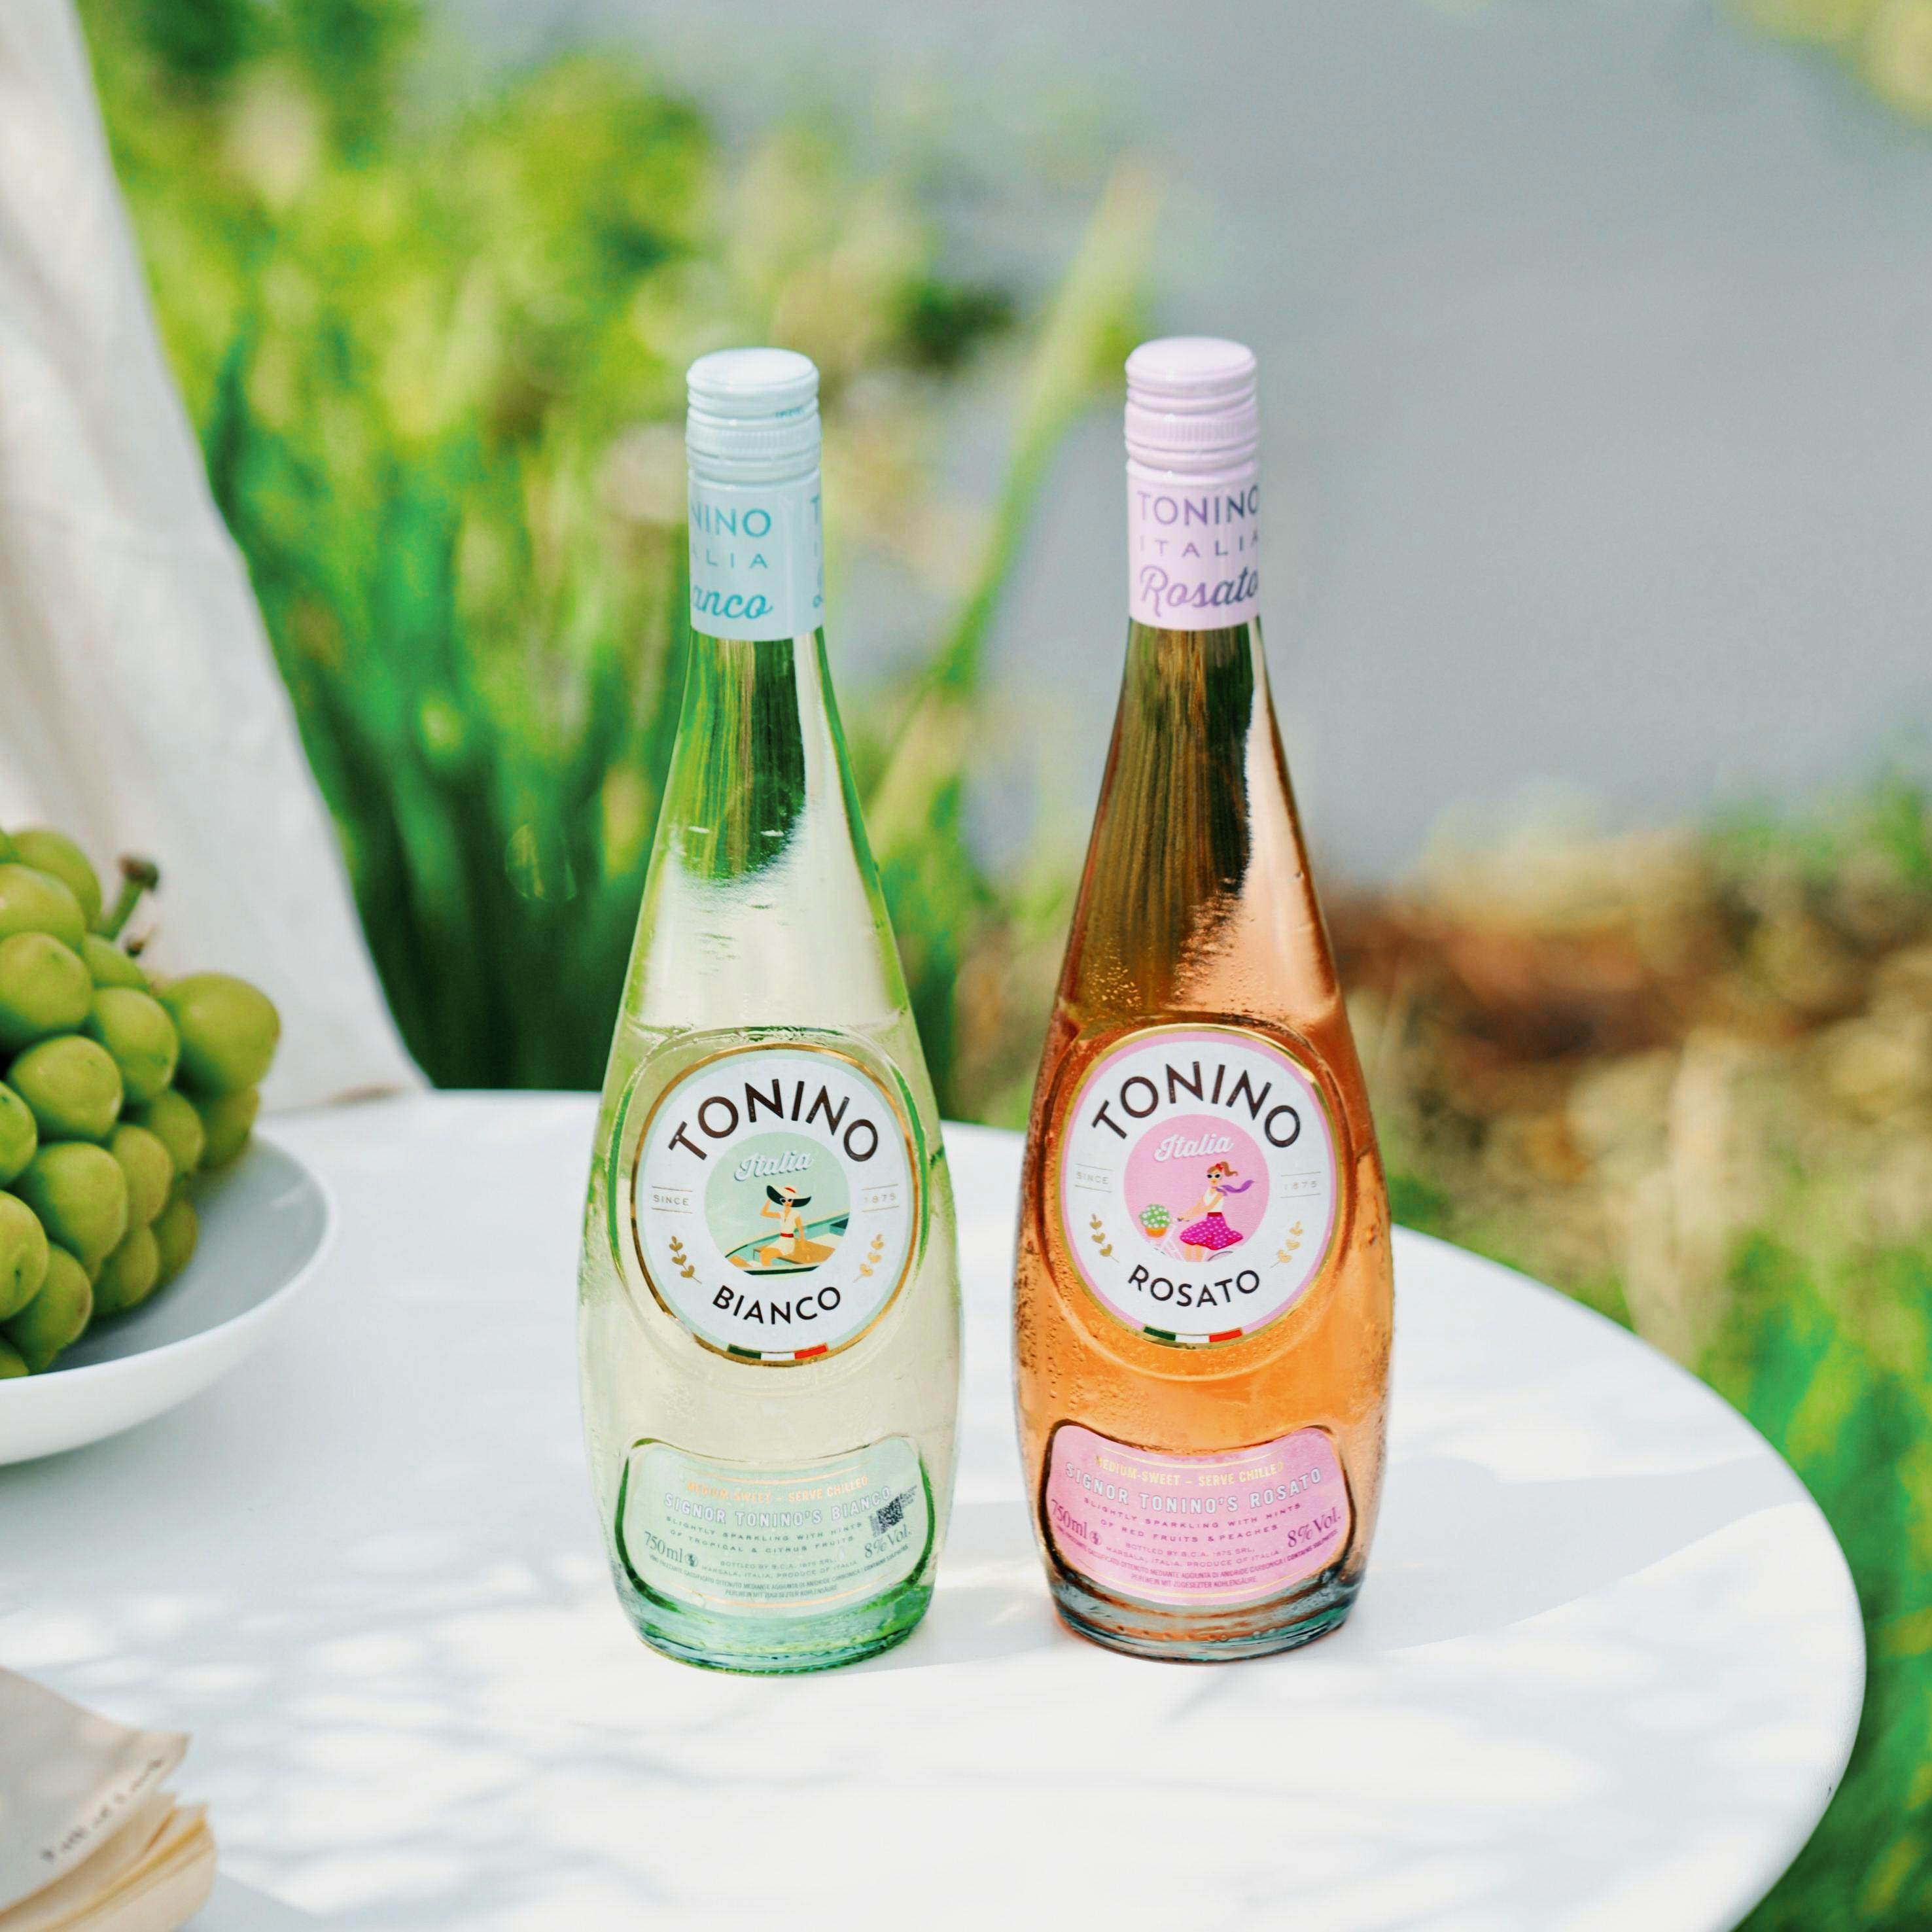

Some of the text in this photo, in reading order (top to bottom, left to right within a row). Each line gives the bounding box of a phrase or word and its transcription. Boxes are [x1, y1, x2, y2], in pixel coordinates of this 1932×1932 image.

[1138, 485, 1257, 525] TONINO
[1140, 565, 1257, 617] Rosato
[668, 1078, 878, 1161] TONINO
[1092, 1061, 1301, 1148] TONINO
[1155, 1133, 1235, 1163] Italia
[734, 1150, 814, 1182] Italia
[1076, 1172, 1317, 1190] SINCE 1875
[654, 1193, 896, 1206] SINCE 1875
[1128, 1264, 1260, 1308] ROSATO
[712, 1285, 841, 1325] BIANCO
[788, 1488, 823, 1502] SERVE
[827, 1475, 868, 1497] CHILLED
[1065, 1462, 1322, 1514] SIGNOR TONINO'S ROSATO
[1198, 1473, 1235, 1487] SERVE
[1238, 1461, 1284, 1483] CHILLED
[665, 1492, 726, 1524] SIGNOR
[735, 1509, 822, 1528] TONINO'S
[831, 1486, 890, 1520] BIANCO
[1051, 1499, 1087, 1539] 750ml
[1083, 1497, 1301, 1528] SLIGHTLY SPARKLING WITH HINTS
[666, 1516, 715, 1535] SLIGHTLY
[723, 1532, 788, 1541] SPARKLING
[831, 1522, 862, 1535] HINTS
[689, 1536, 743, 1552] TROPICAL
[815, 1536, 853, 1549] FRUITS
[1100, 1519, 1114, 1527] OF
[1121, 1527, 1144, 1537] RED
[1153, 1534, 1199, 1543] FRUITS
[1220, 1524, 1278, 1541] PEACHES
[644, 1531, 683, 1563] 750ml
[1125, 1543, 1163, 1555] BOTTLED
